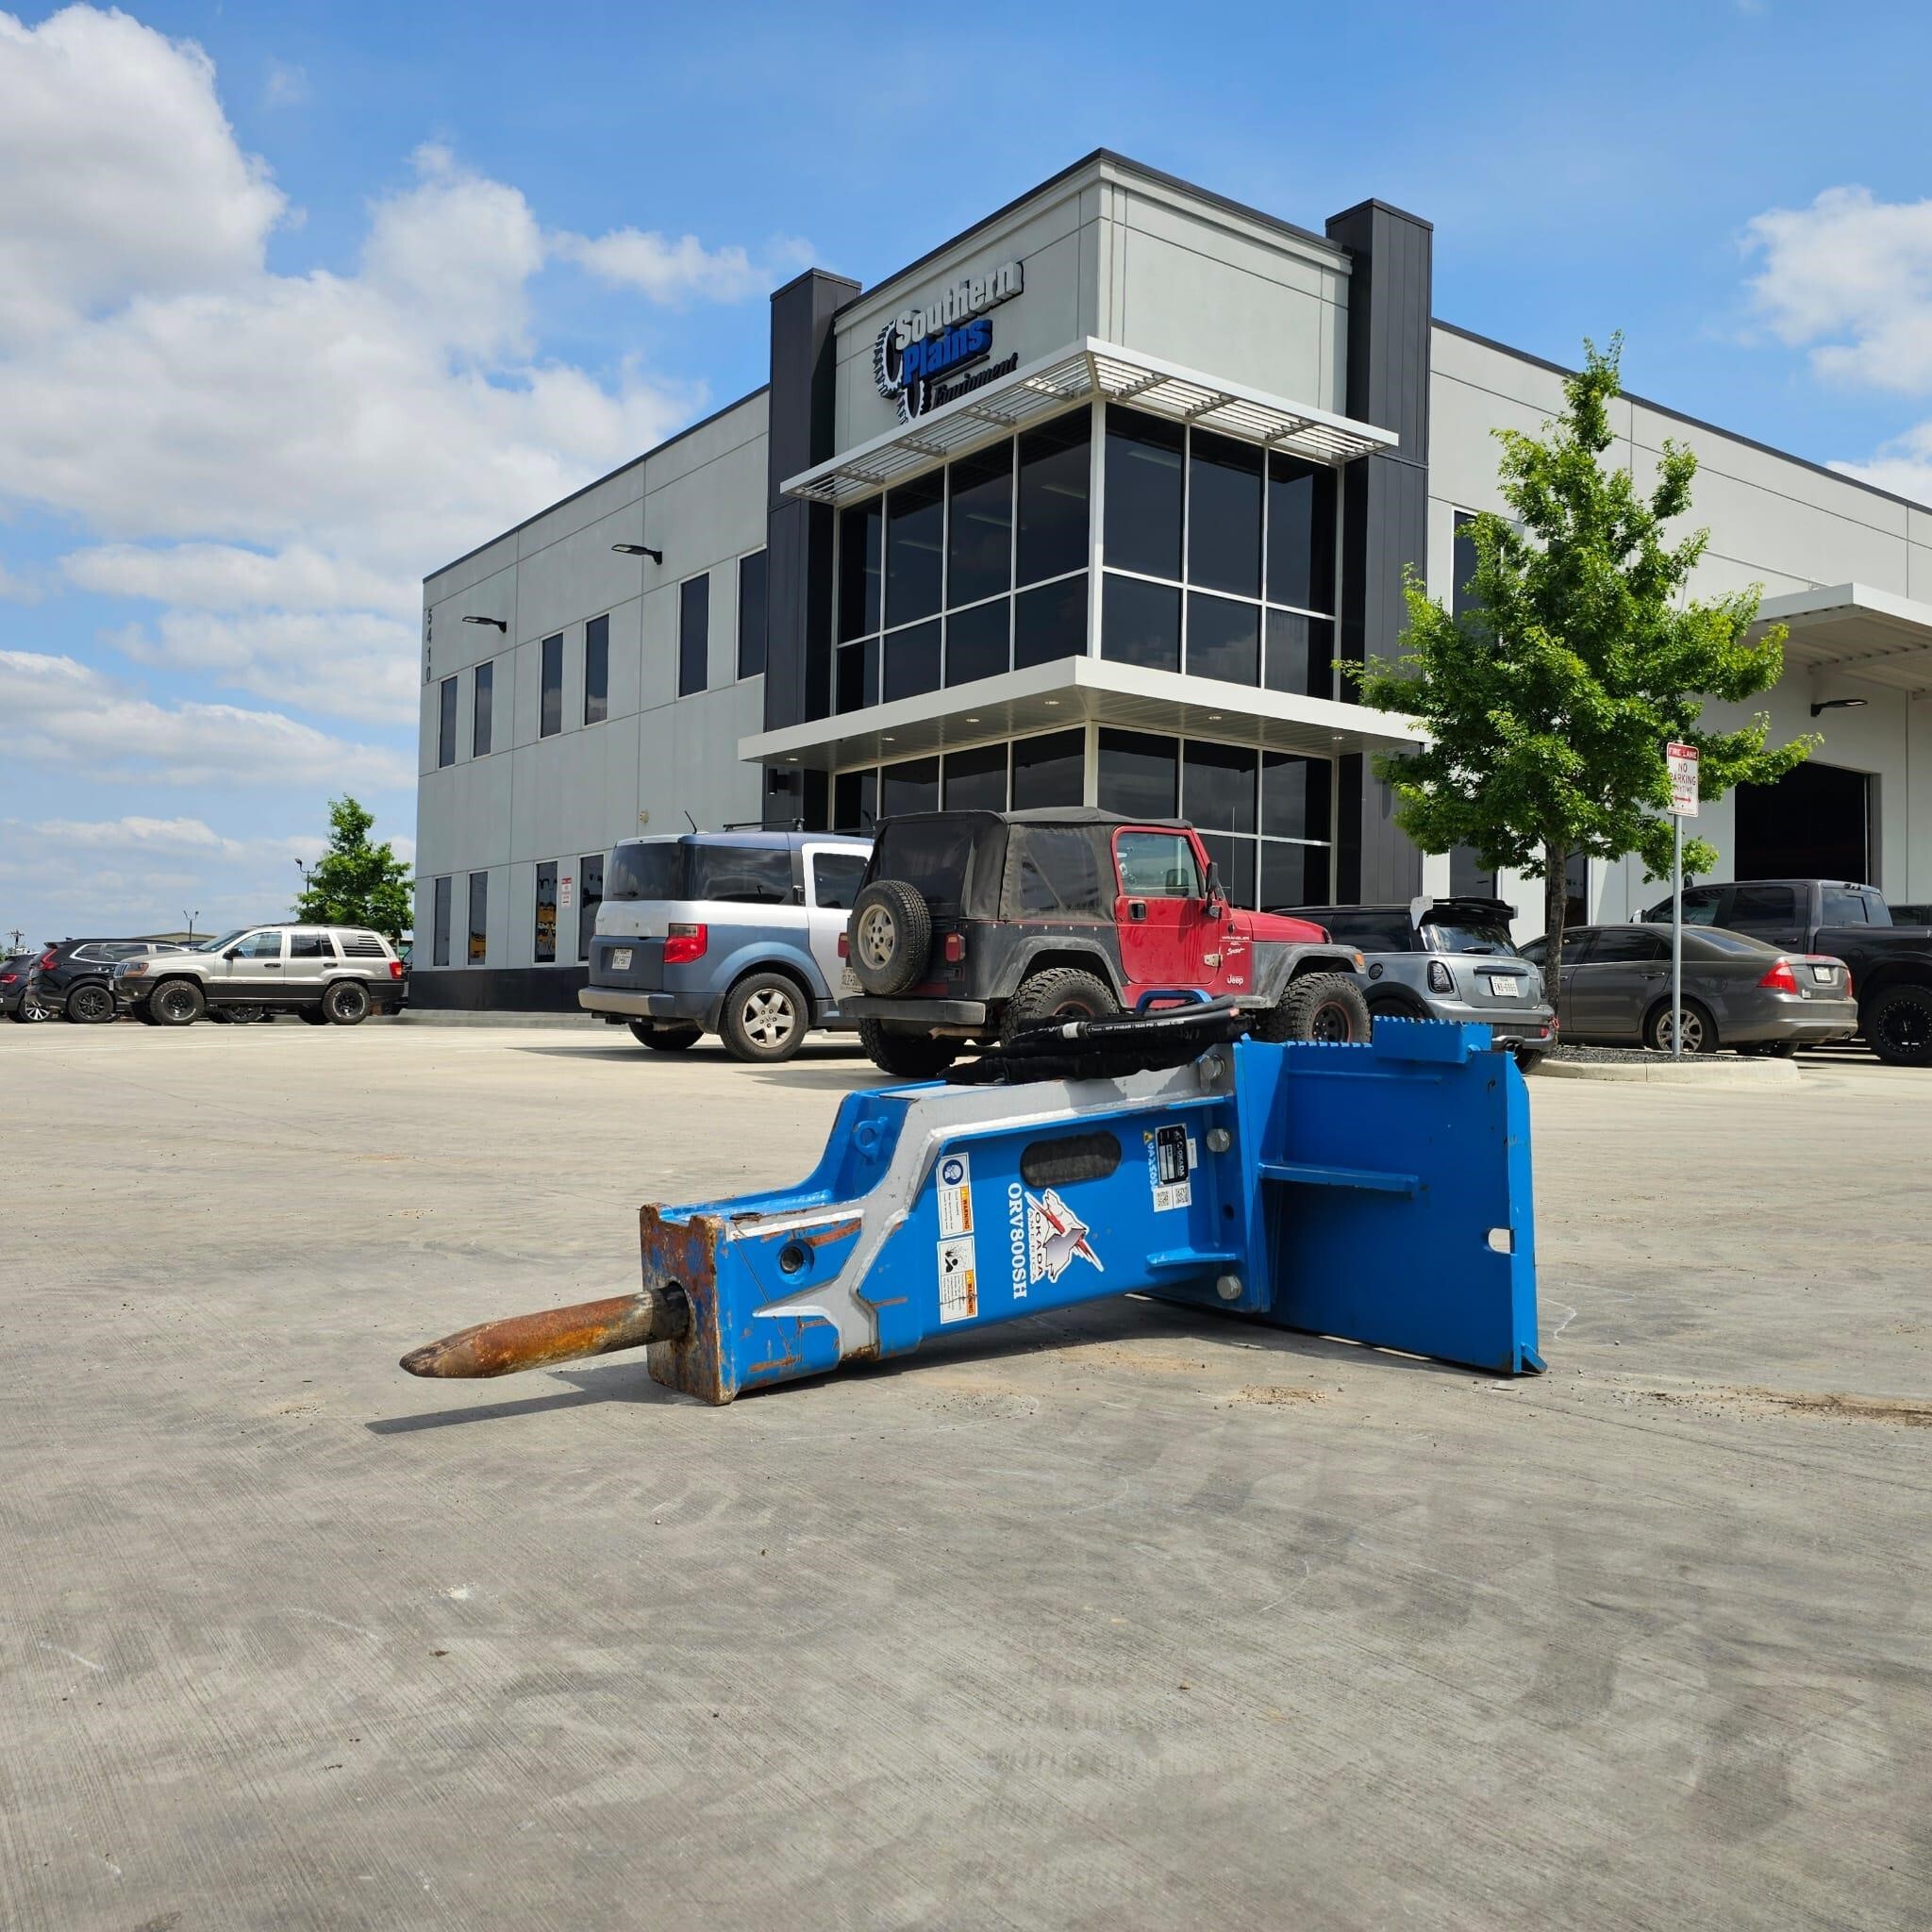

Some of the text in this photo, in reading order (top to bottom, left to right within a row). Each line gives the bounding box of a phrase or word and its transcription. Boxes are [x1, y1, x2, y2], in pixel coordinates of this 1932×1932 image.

[895, 261, 1019, 350] Southern
[903, 320, 989, 385] Plains
[932, 353, 1018, 409] Equipment
[1669, 747, 1697, 759] FIRE LANE
[1678, 762, 1688, 773] NO
[1669, 772, 1696, 786] PARKING
[1226, 974, 1244, 986] Jeep
[962, 1199, 971, 1230] WARNING
[1008, 1183, 1027, 1300] ORV800SH
[1035, 1211, 1044, 1276] OKADA
